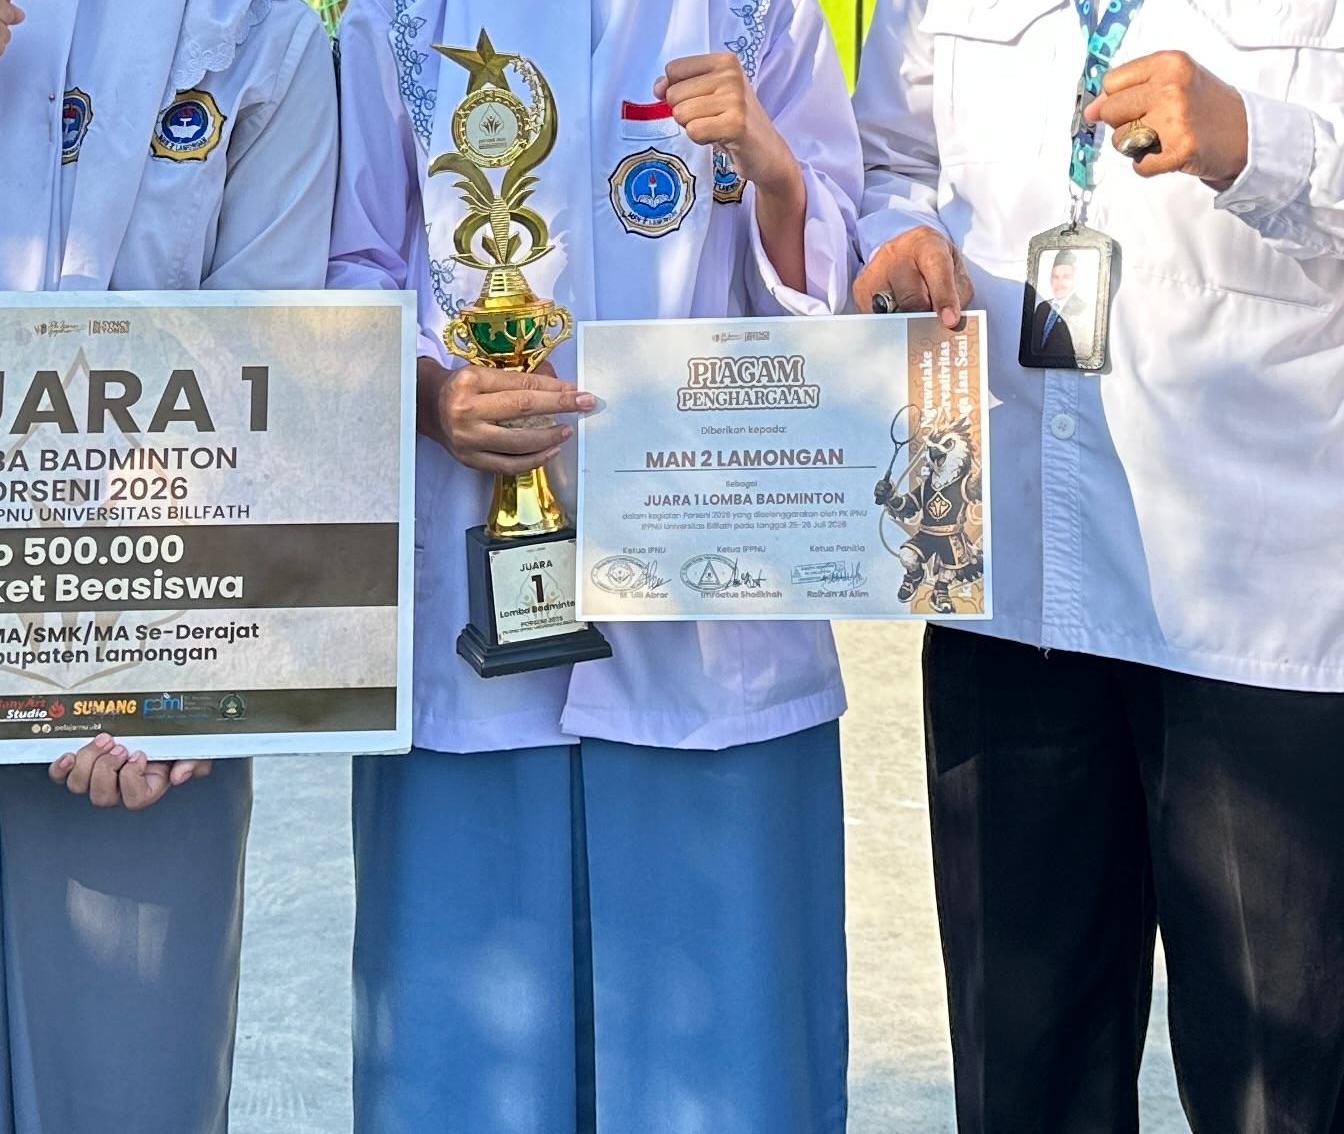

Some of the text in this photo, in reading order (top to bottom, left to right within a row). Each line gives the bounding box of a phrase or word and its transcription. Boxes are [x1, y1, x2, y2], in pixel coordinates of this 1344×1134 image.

[954, 335, 969, 367] Seni
[691, 359, 801, 385] PIAGAM
[241, 366, 269, 432] 1
[681, 388, 816, 407] PENGHARGAAN
[701, 426, 746, 435] Diberikan
[40, 446, 238, 471] BADMINTON
[646, 448, 844, 468] MAN 2 LAMONGAN
[110, 476, 189, 501] 2026
[644, 491, 845, 507] JUARA 1 LOMBA BADMINTON
[39, 507, 162, 522] UNIVERSITAS
[167, 505, 250, 520] BILLFATH
[24, 534, 184, 567] 500.000
[622, 546, 646, 554] Ketua
[717, 545, 741, 553] Ketua
[520, 560, 553, 572] JUARA
[56, 569, 243, 603] Beasiswa
[531, 574, 544, 602] 1
[500, 601, 575, 618] Lomba Badminto
[135, 621, 260, 643] Se-Derajat
[96, 645, 218, 666] Lamongan
[6, 708, 48, 719] Studio
[73, 699, 137, 715] SUMANG
